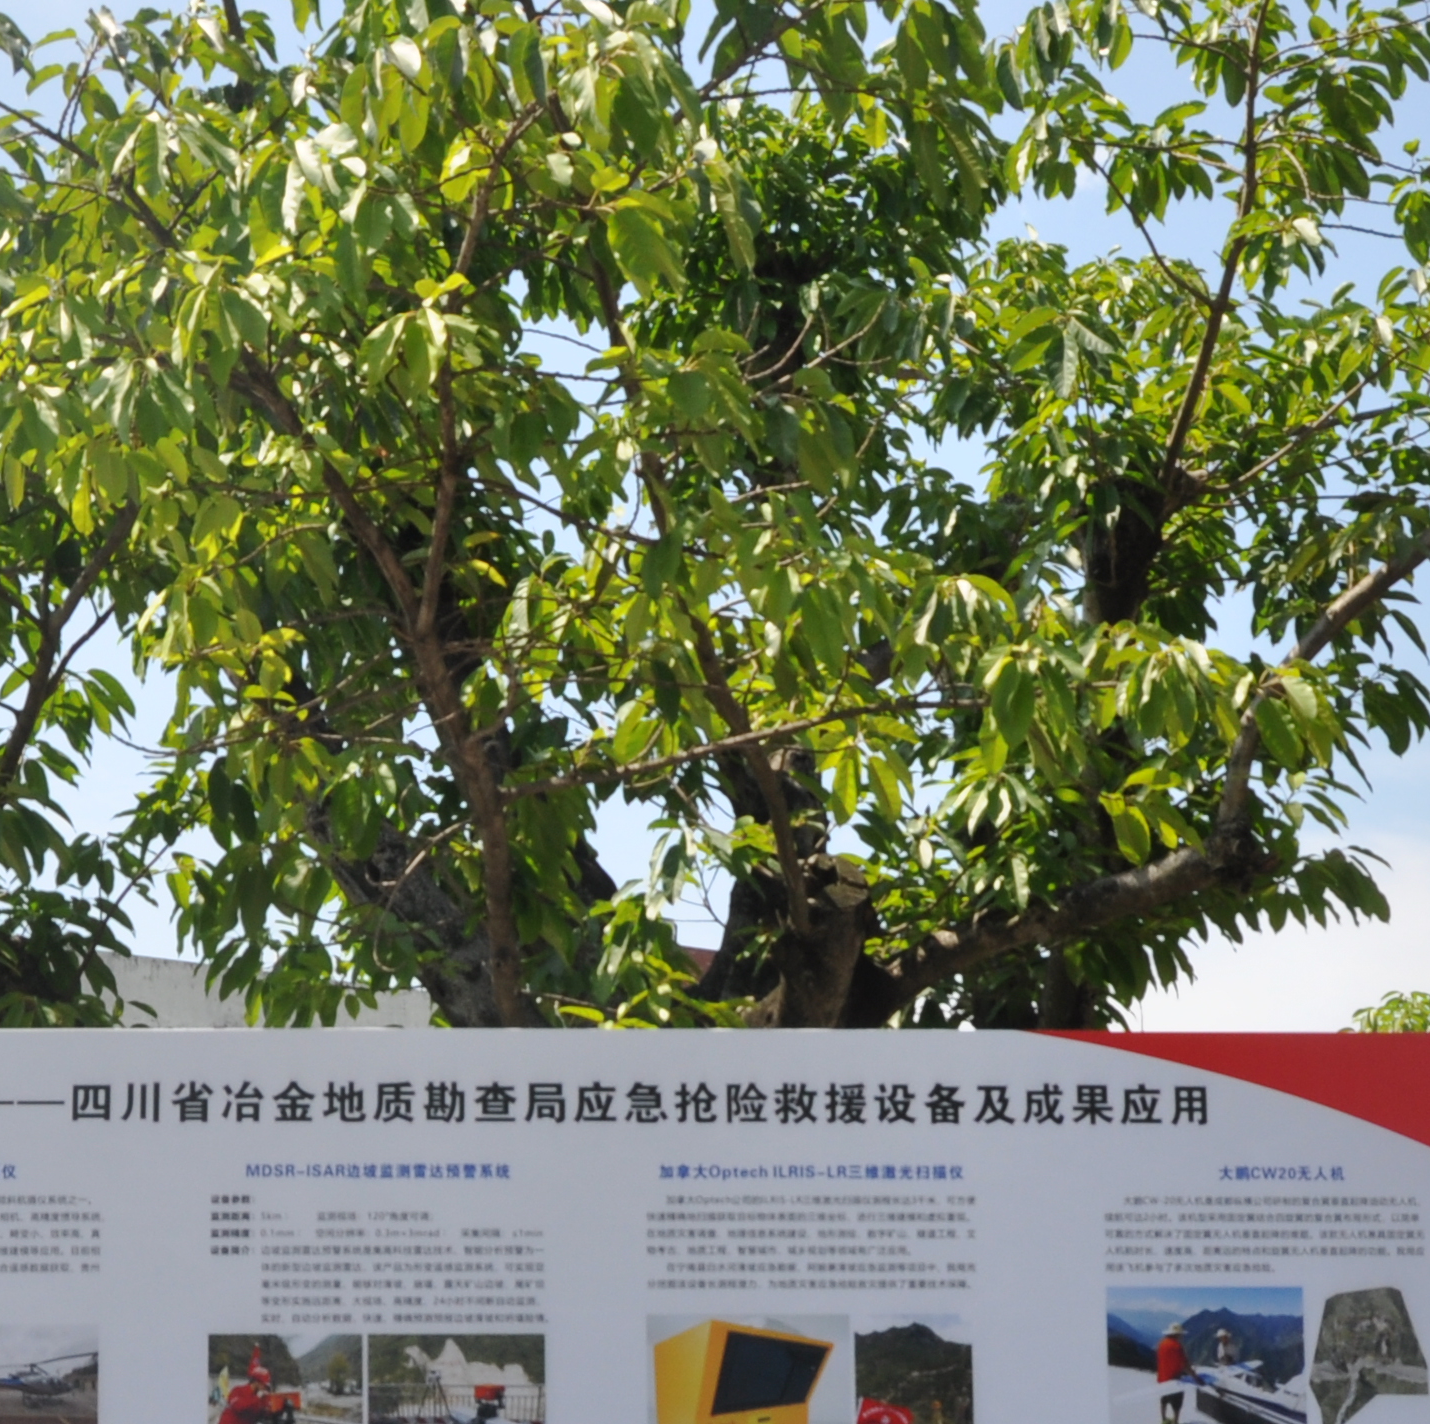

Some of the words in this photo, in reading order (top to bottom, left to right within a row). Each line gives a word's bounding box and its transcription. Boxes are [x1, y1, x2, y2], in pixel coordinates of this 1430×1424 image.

[1218, 1165, 1347, 1182] 大鹏CW20无人机
